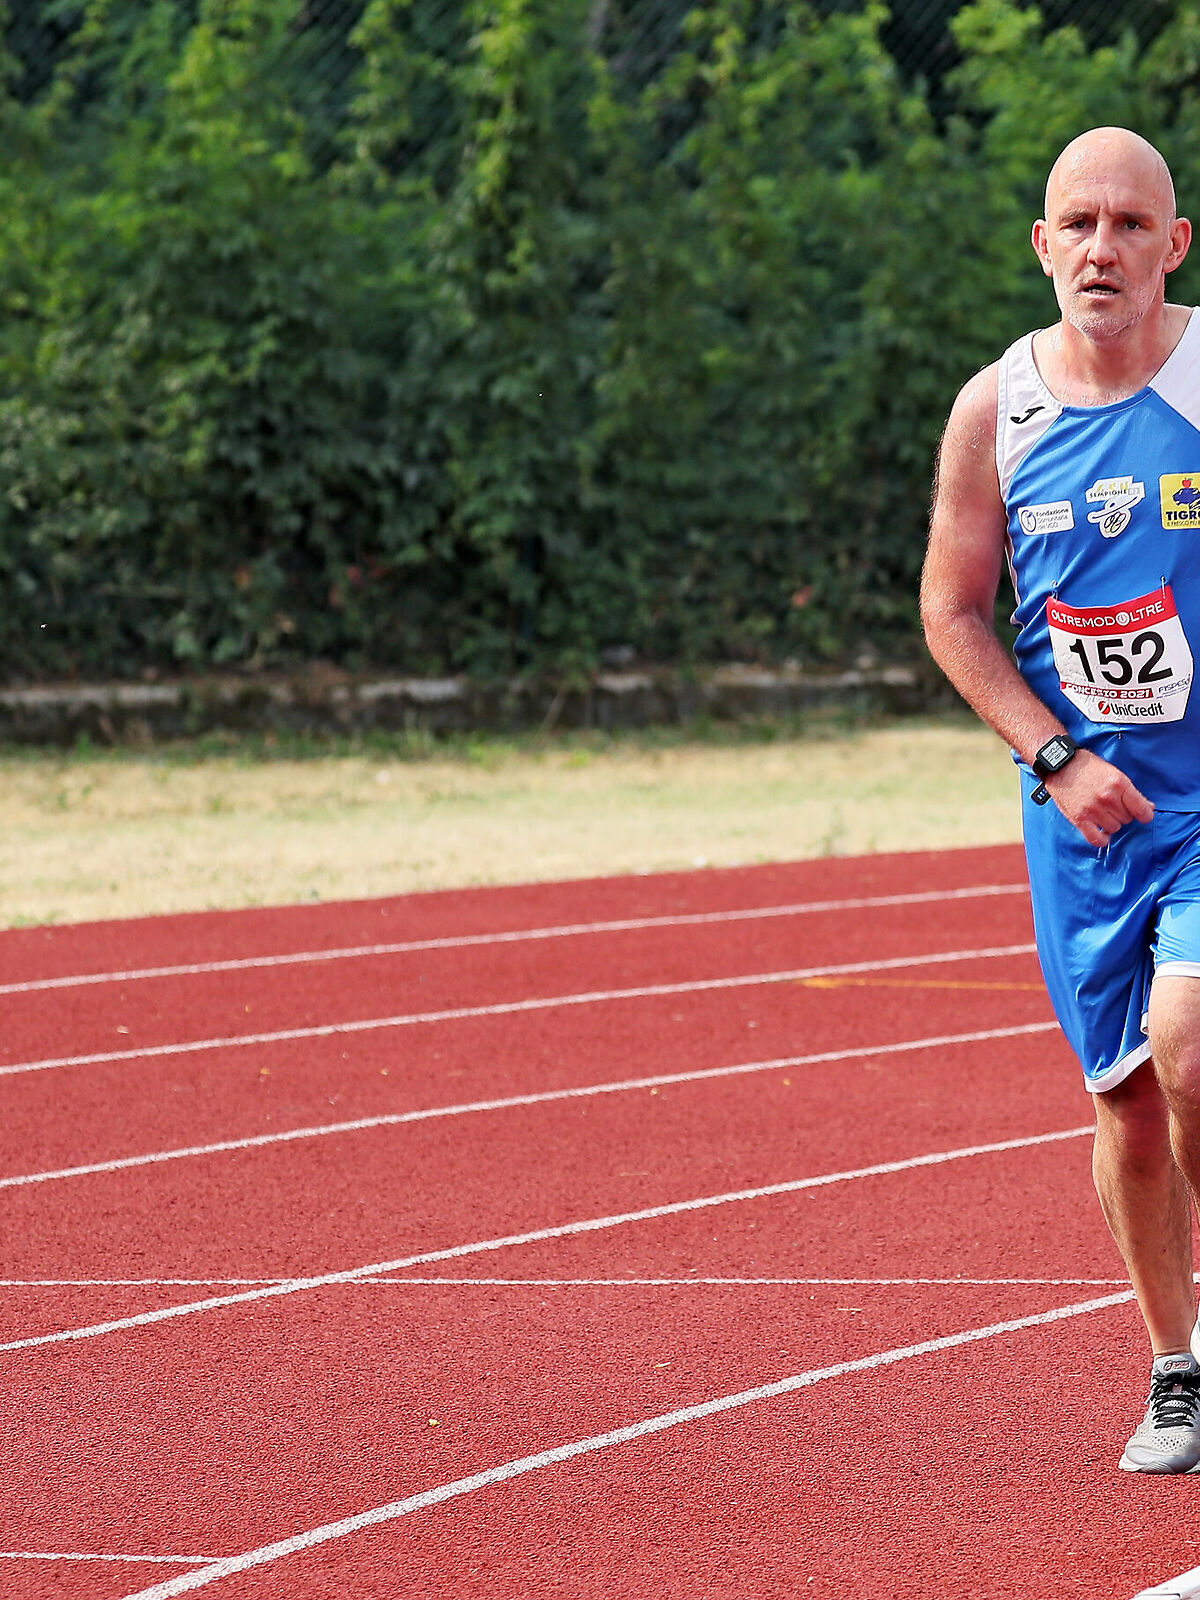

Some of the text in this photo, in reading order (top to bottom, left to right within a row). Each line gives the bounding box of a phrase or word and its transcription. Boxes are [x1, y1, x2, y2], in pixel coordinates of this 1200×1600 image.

[1089, 489, 1127, 498] SEMPIONE
[1069, 631, 1173, 685] 152
[1120, 689, 1150, 699] 2021
[1110, 702, 1165, 717] UniCredit
